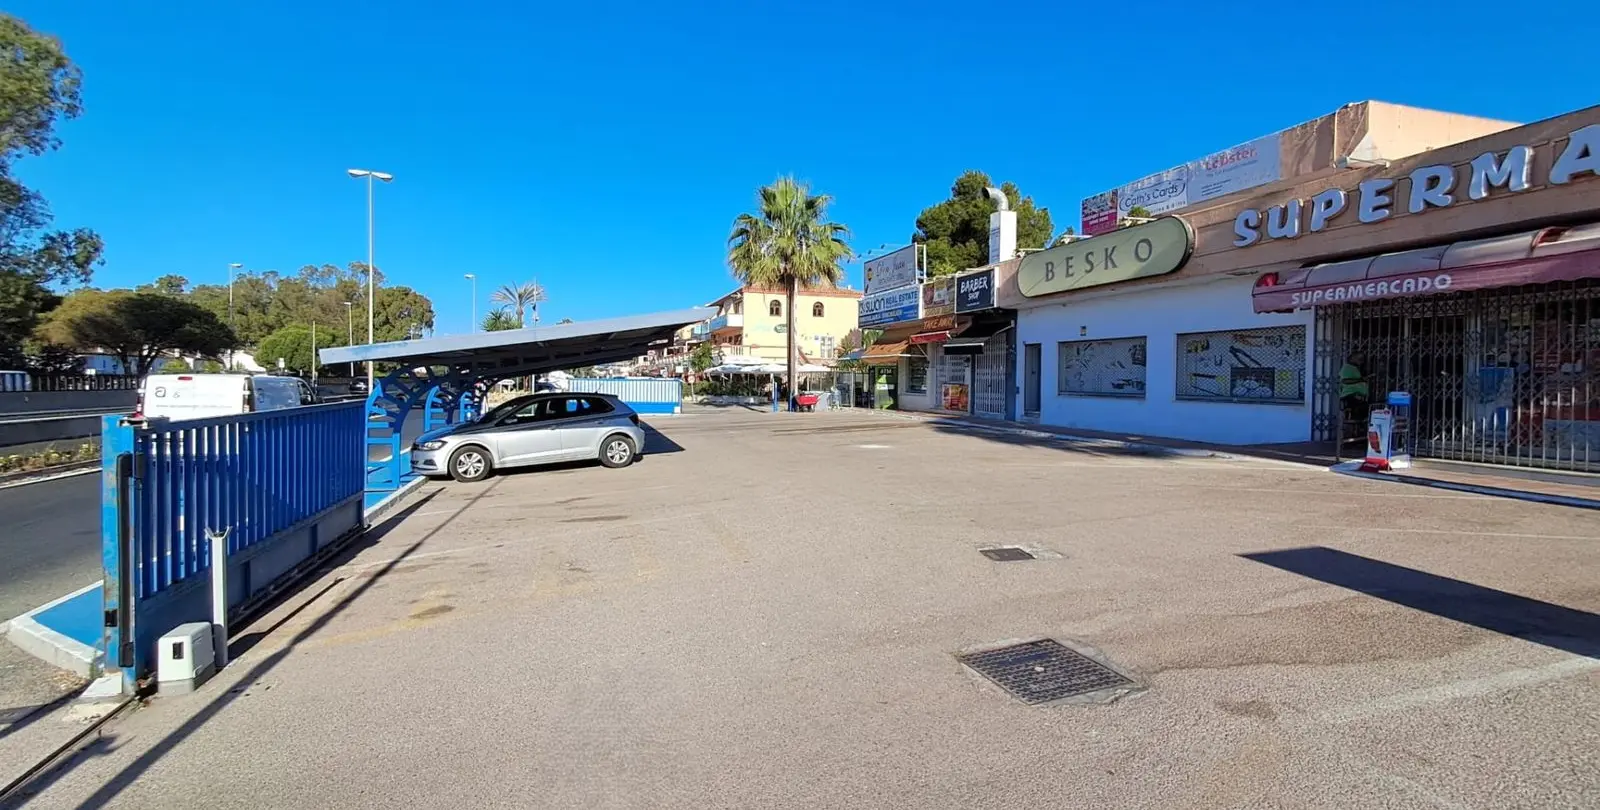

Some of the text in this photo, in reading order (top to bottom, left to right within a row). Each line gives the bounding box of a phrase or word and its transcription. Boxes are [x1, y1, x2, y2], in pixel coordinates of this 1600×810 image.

[1232, 123, 1600, 248] SUPERMA
[1124, 182, 1178, 208] Cath's Cards
[960, 277, 988, 293] BARBER
[1291, 274, 1451, 305] SUPERMERCADO
[886, 294, 898, 304] REAL
[899, 290, 918, 302] ESTATE
[968, 291, 980, 301] SHOP
[923, 319, 938, 330] TAKE
